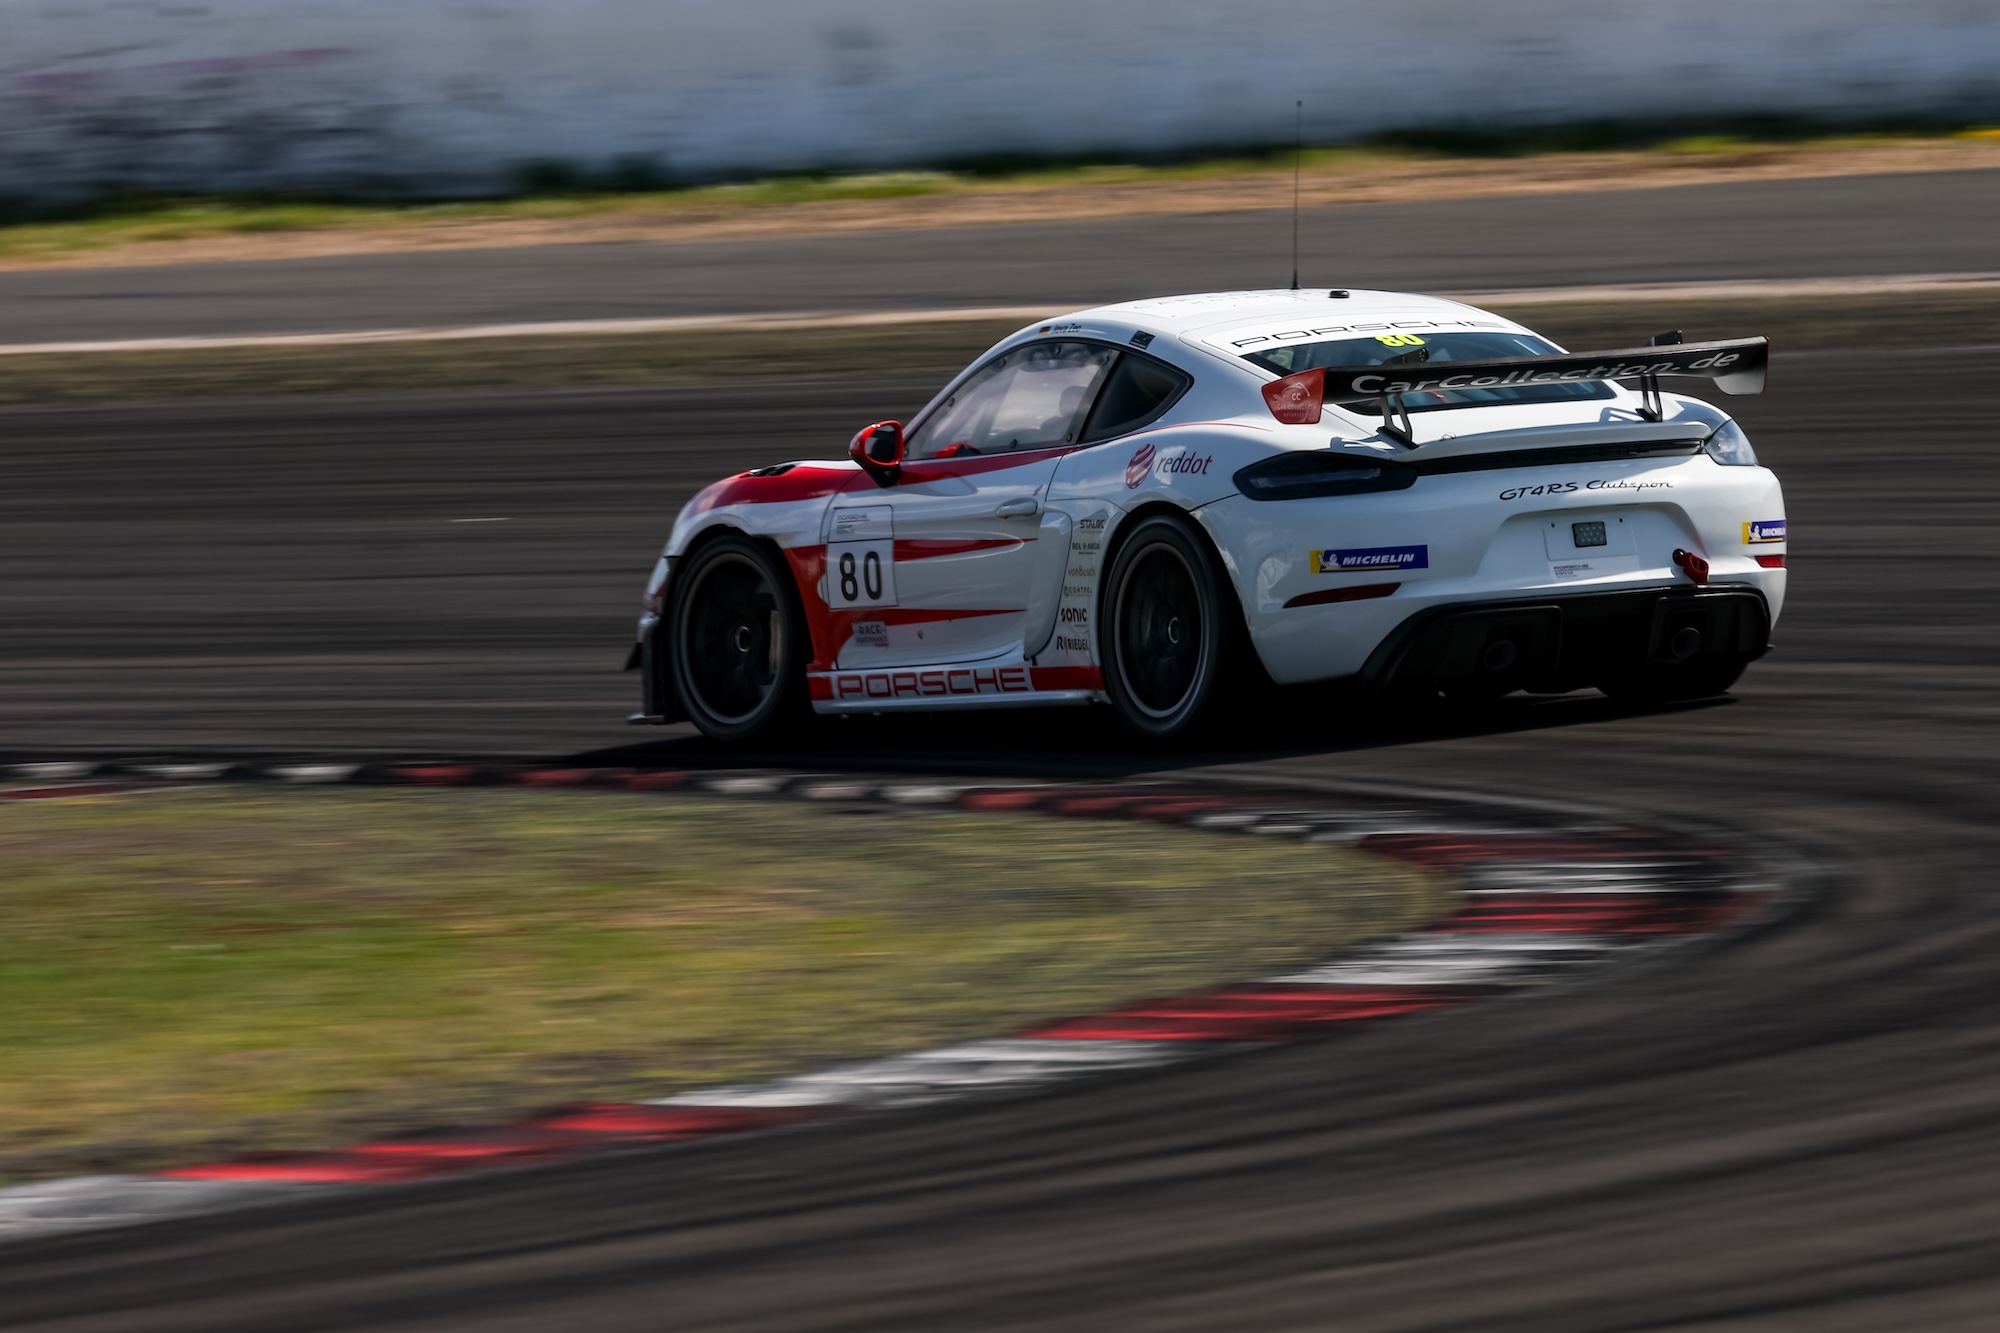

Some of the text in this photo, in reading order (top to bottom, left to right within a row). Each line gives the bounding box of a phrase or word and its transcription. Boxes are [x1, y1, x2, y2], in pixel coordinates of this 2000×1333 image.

[1230, 320, 1507, 348] PORSCHE
[1374, 334, 1426, 347] 80
[1351, 351, 1740, 394] CarCollection.de
[1155, 451, 1213, 475] reddot
[1499, 481, 1579, 501] GT4RS
[1341, 553, 1415, 566] MICHELIN
[839, 551, 882, 602] 80
[858, 624, 882, 635] RACE
[837, 668, 1028, 698] PORSCHE
